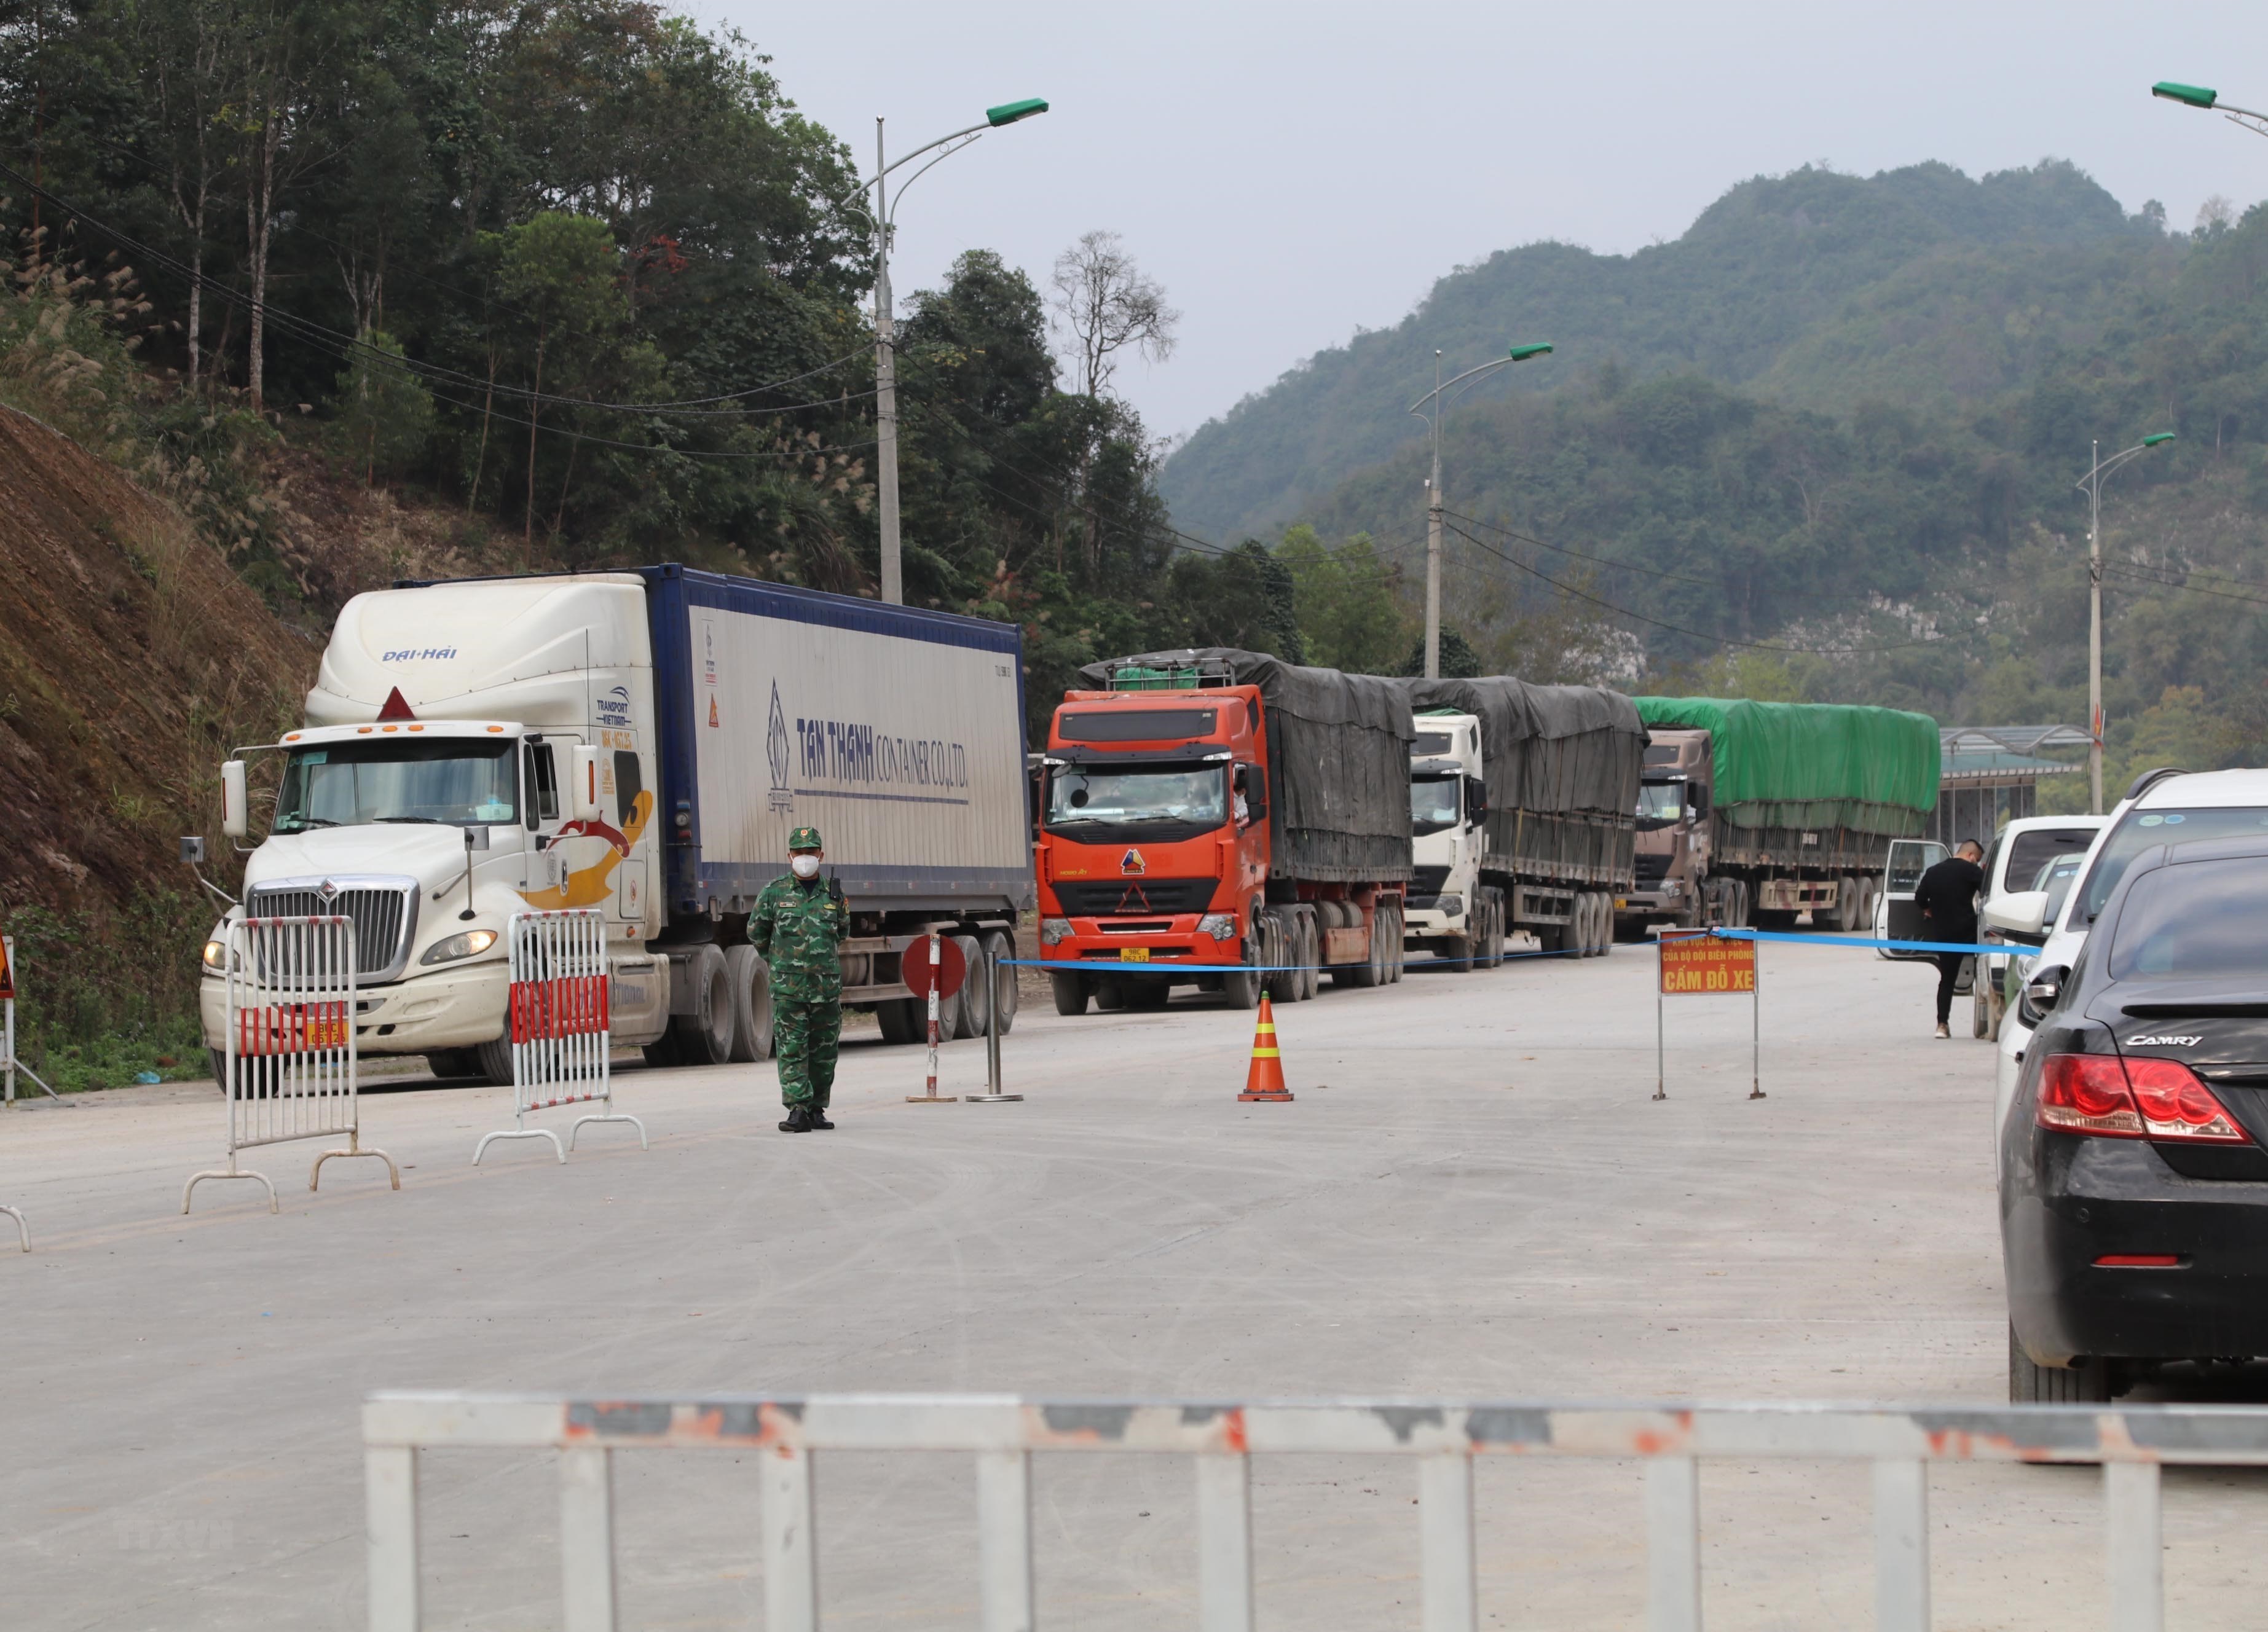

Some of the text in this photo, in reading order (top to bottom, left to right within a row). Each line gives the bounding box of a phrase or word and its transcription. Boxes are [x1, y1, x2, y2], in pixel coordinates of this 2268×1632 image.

[597, 700, 628, 713] TRANSPORT
[797, 718, 827, 783] TAN
[827, 721, 875, 787] THANH
[875, 734, 931, 785] CONTAINER
[1665, 963, 1753, 990] CẤM ĐỖ XE
[2126, 1035, 2203, 1047] CAMRY
